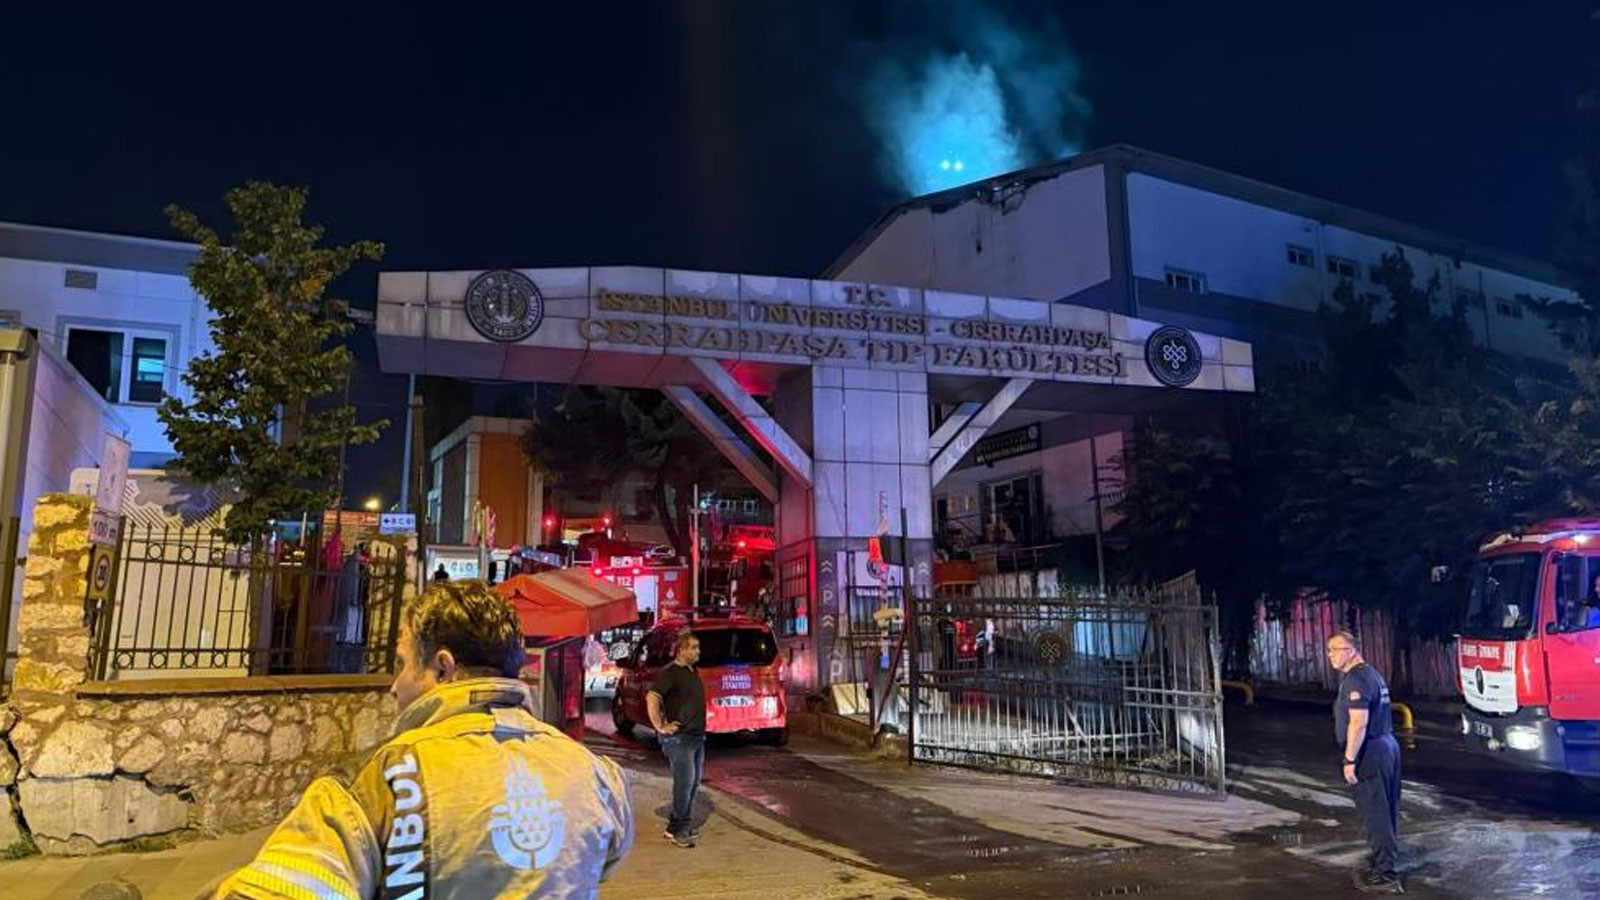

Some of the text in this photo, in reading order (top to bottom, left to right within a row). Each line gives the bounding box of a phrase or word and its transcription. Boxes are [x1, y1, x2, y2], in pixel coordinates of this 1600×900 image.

[845, 285, 891, 308] T.C.
[579, 319, 852, 359] CERRAHPAŞA
[859, 338, 927, 363] TIP
[933, 343, 1128, 377] FAKÜLTESİ
[949, 320, 1112, 350] CERRAHPAŞA
